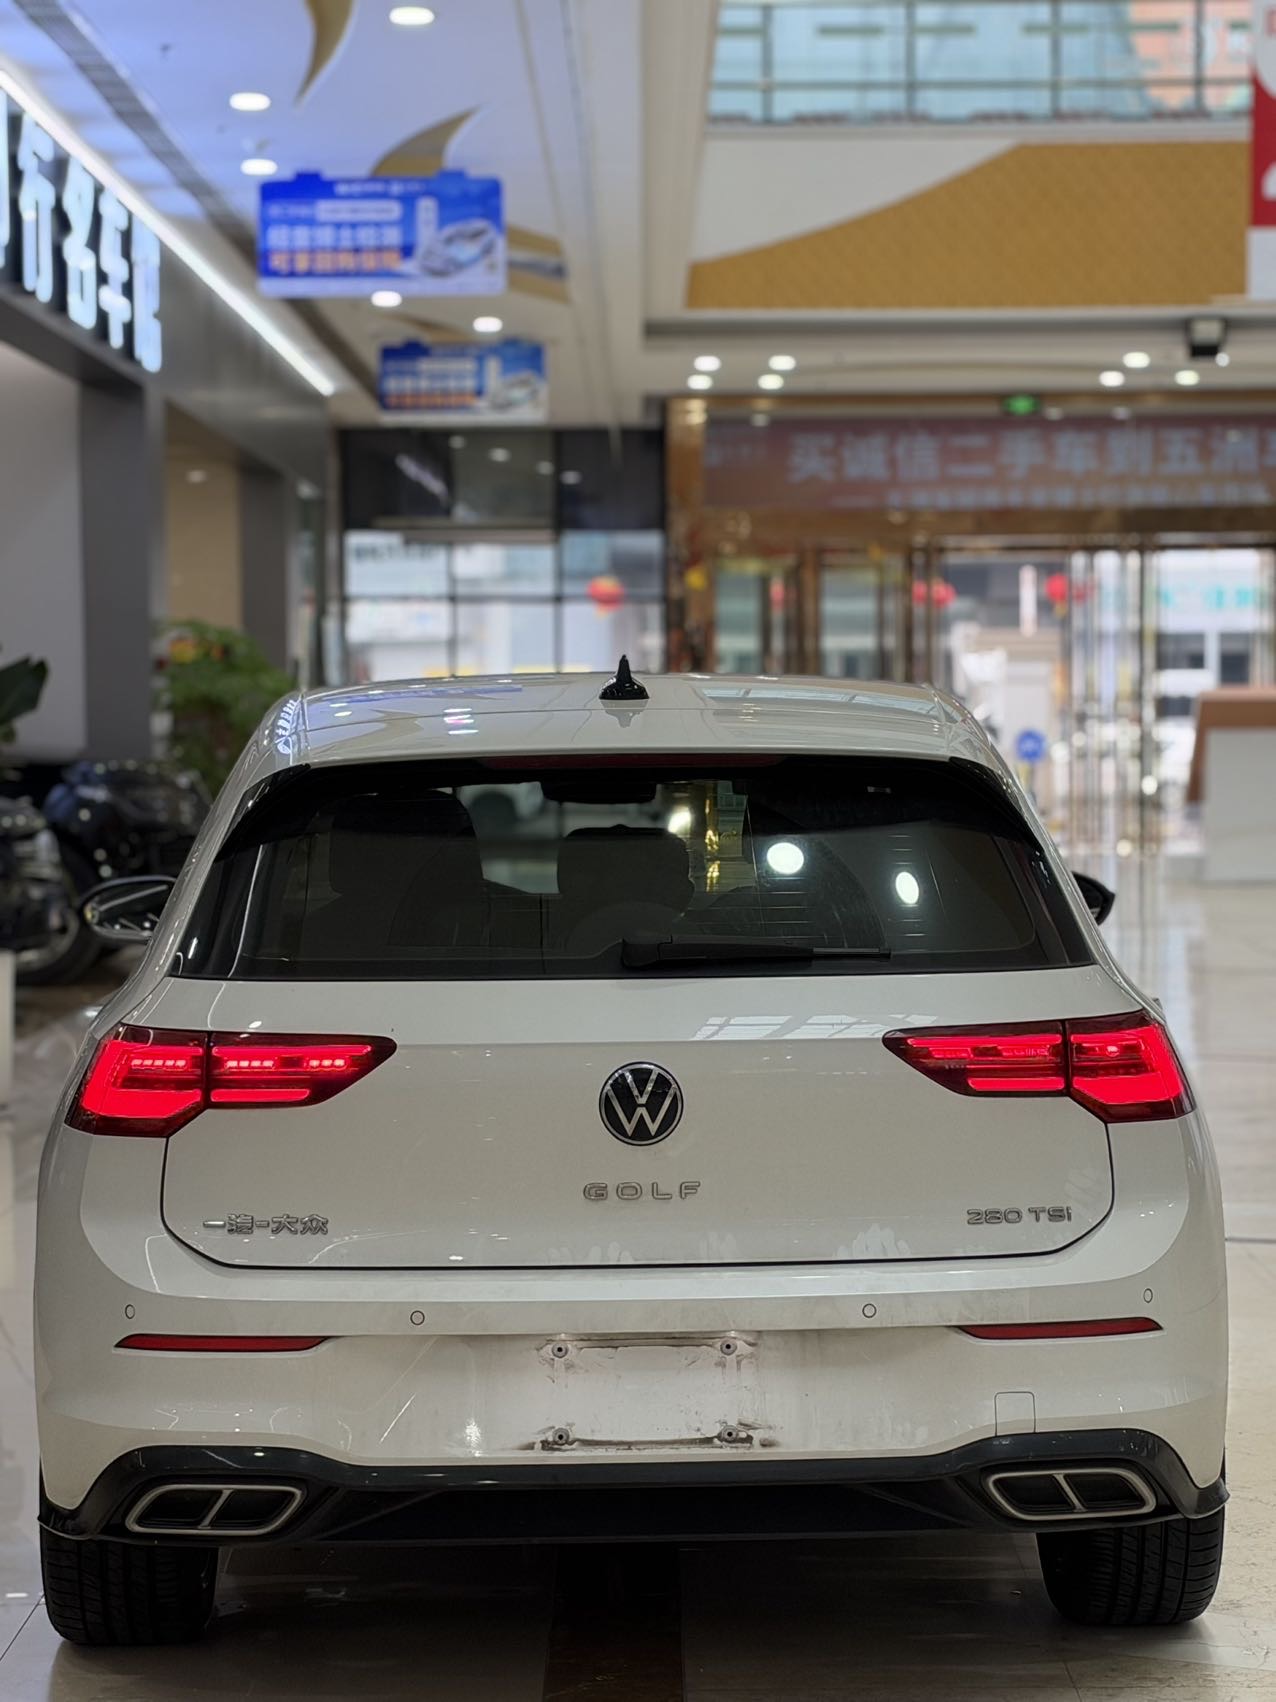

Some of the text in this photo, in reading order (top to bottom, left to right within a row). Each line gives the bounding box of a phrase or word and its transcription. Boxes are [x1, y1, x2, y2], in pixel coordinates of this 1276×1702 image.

[786, 427, 1276, 484] 买诚信二手车到五洲
[583, 1181, 701, 1201] GOLF
[203, 1214, 328, 1234] 一汽-大众
[966, 1207, 1023, 1225] 280
